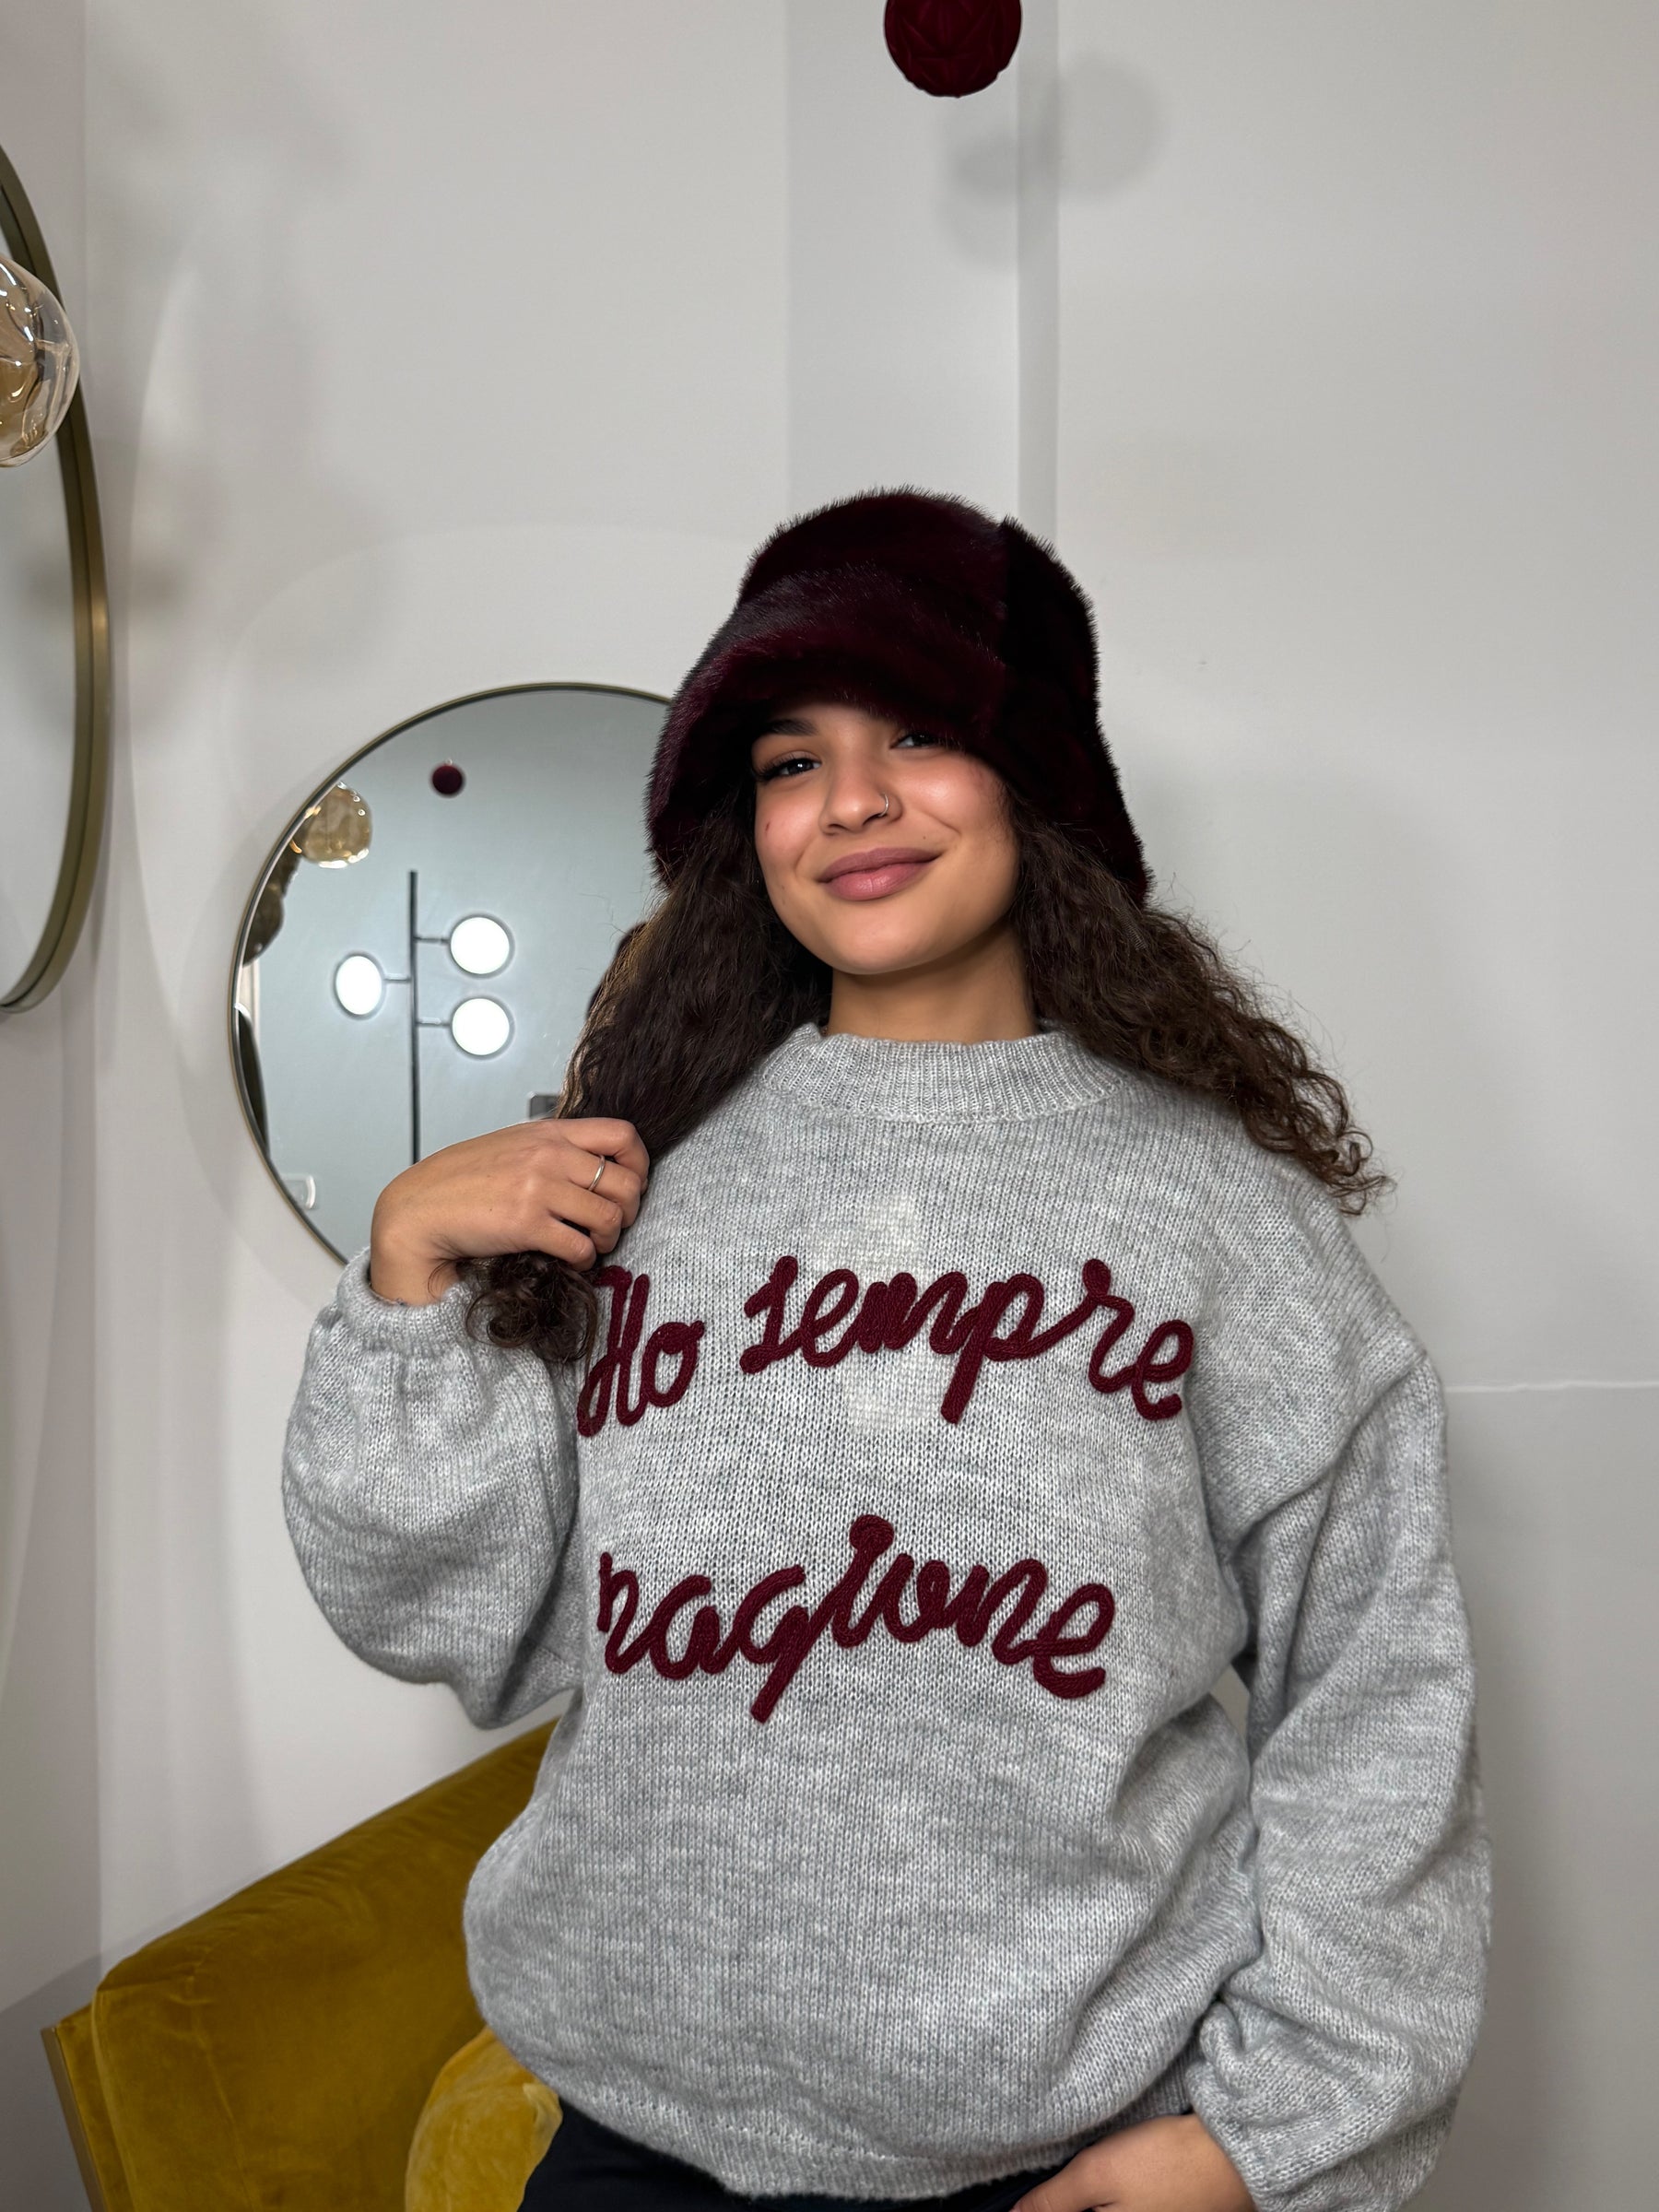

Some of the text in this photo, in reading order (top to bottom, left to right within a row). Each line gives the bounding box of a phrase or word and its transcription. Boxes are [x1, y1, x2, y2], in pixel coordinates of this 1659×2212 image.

[577, 1256, 1194, 1438] Ho sempre
[597, 1515, 1115, 1723] ragione
